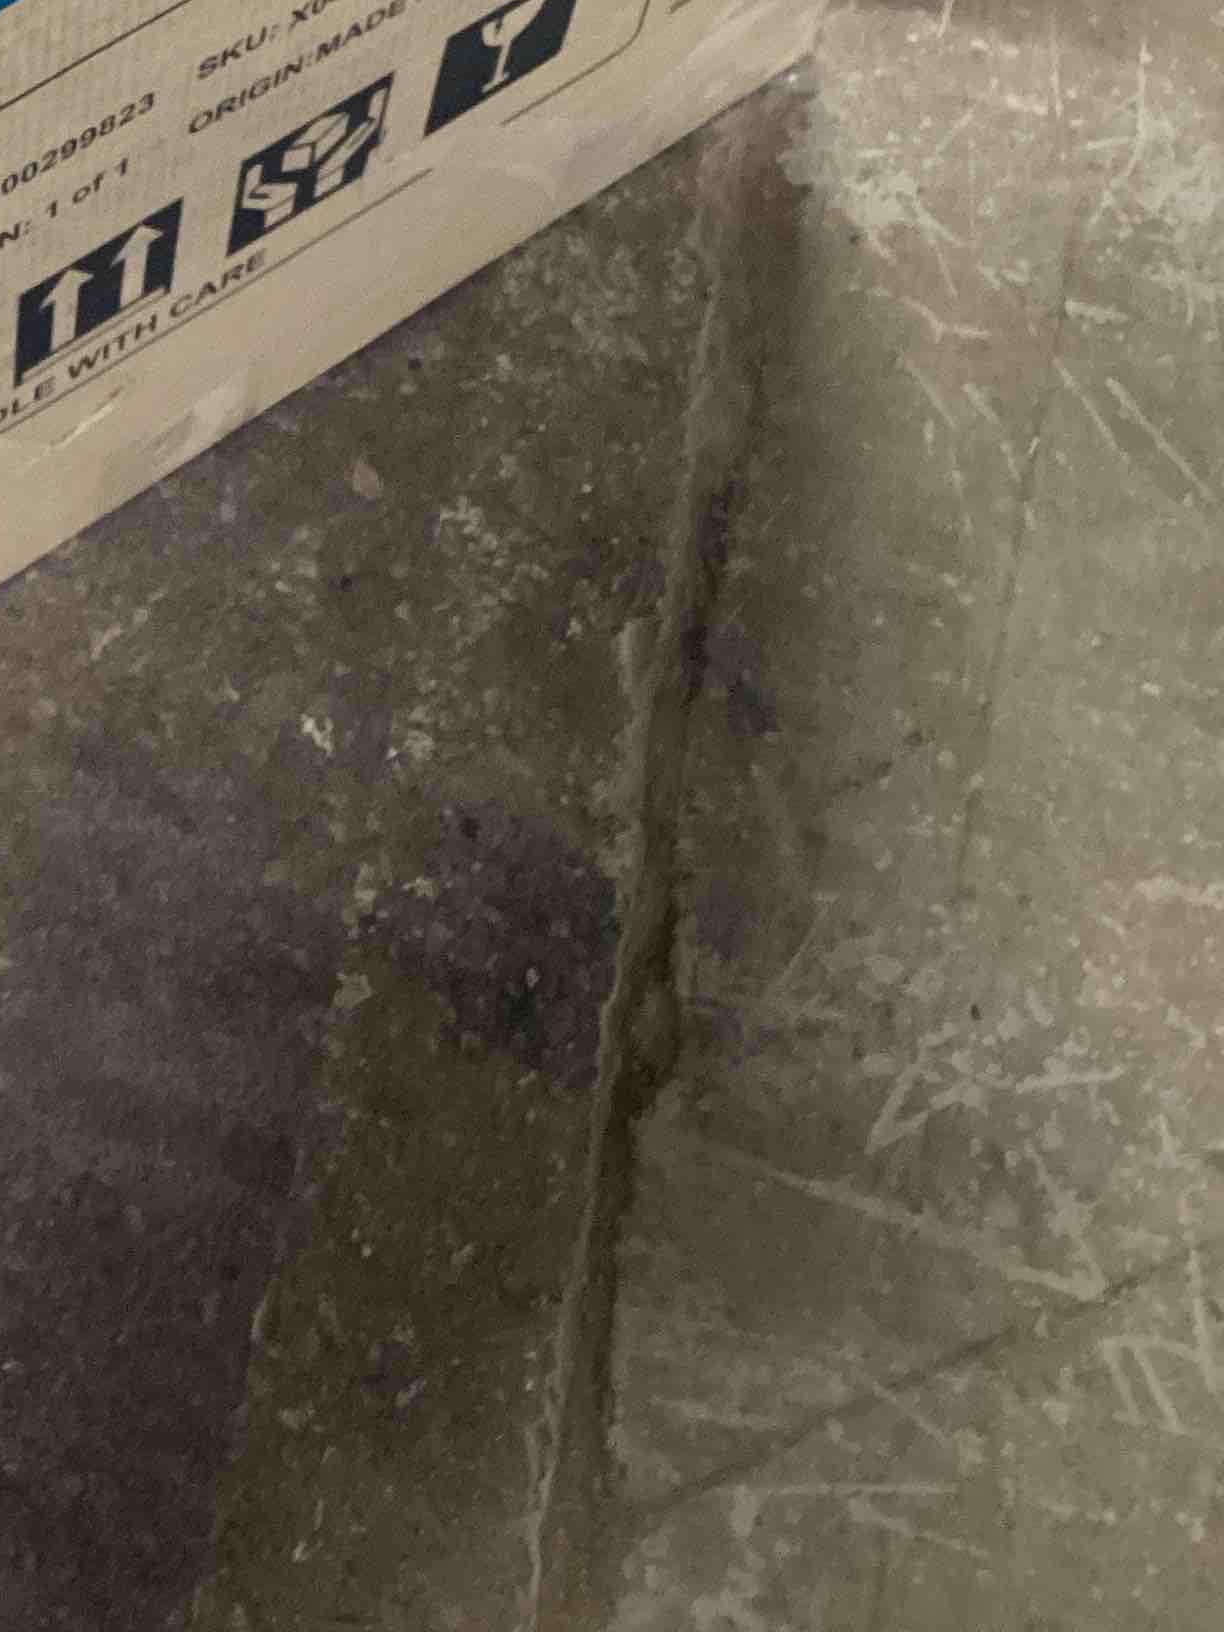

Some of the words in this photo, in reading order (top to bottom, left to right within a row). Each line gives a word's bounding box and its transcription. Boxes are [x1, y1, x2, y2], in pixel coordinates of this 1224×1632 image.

[196, 23, 282, 82] SKU:
[45, 197, 61, 221] 1
[71, 169, 110, 206] of
[117, 157, 132, 180] 1
[66, 311, 159, 380] WITH
[169, 248, 267, 318] CARE
